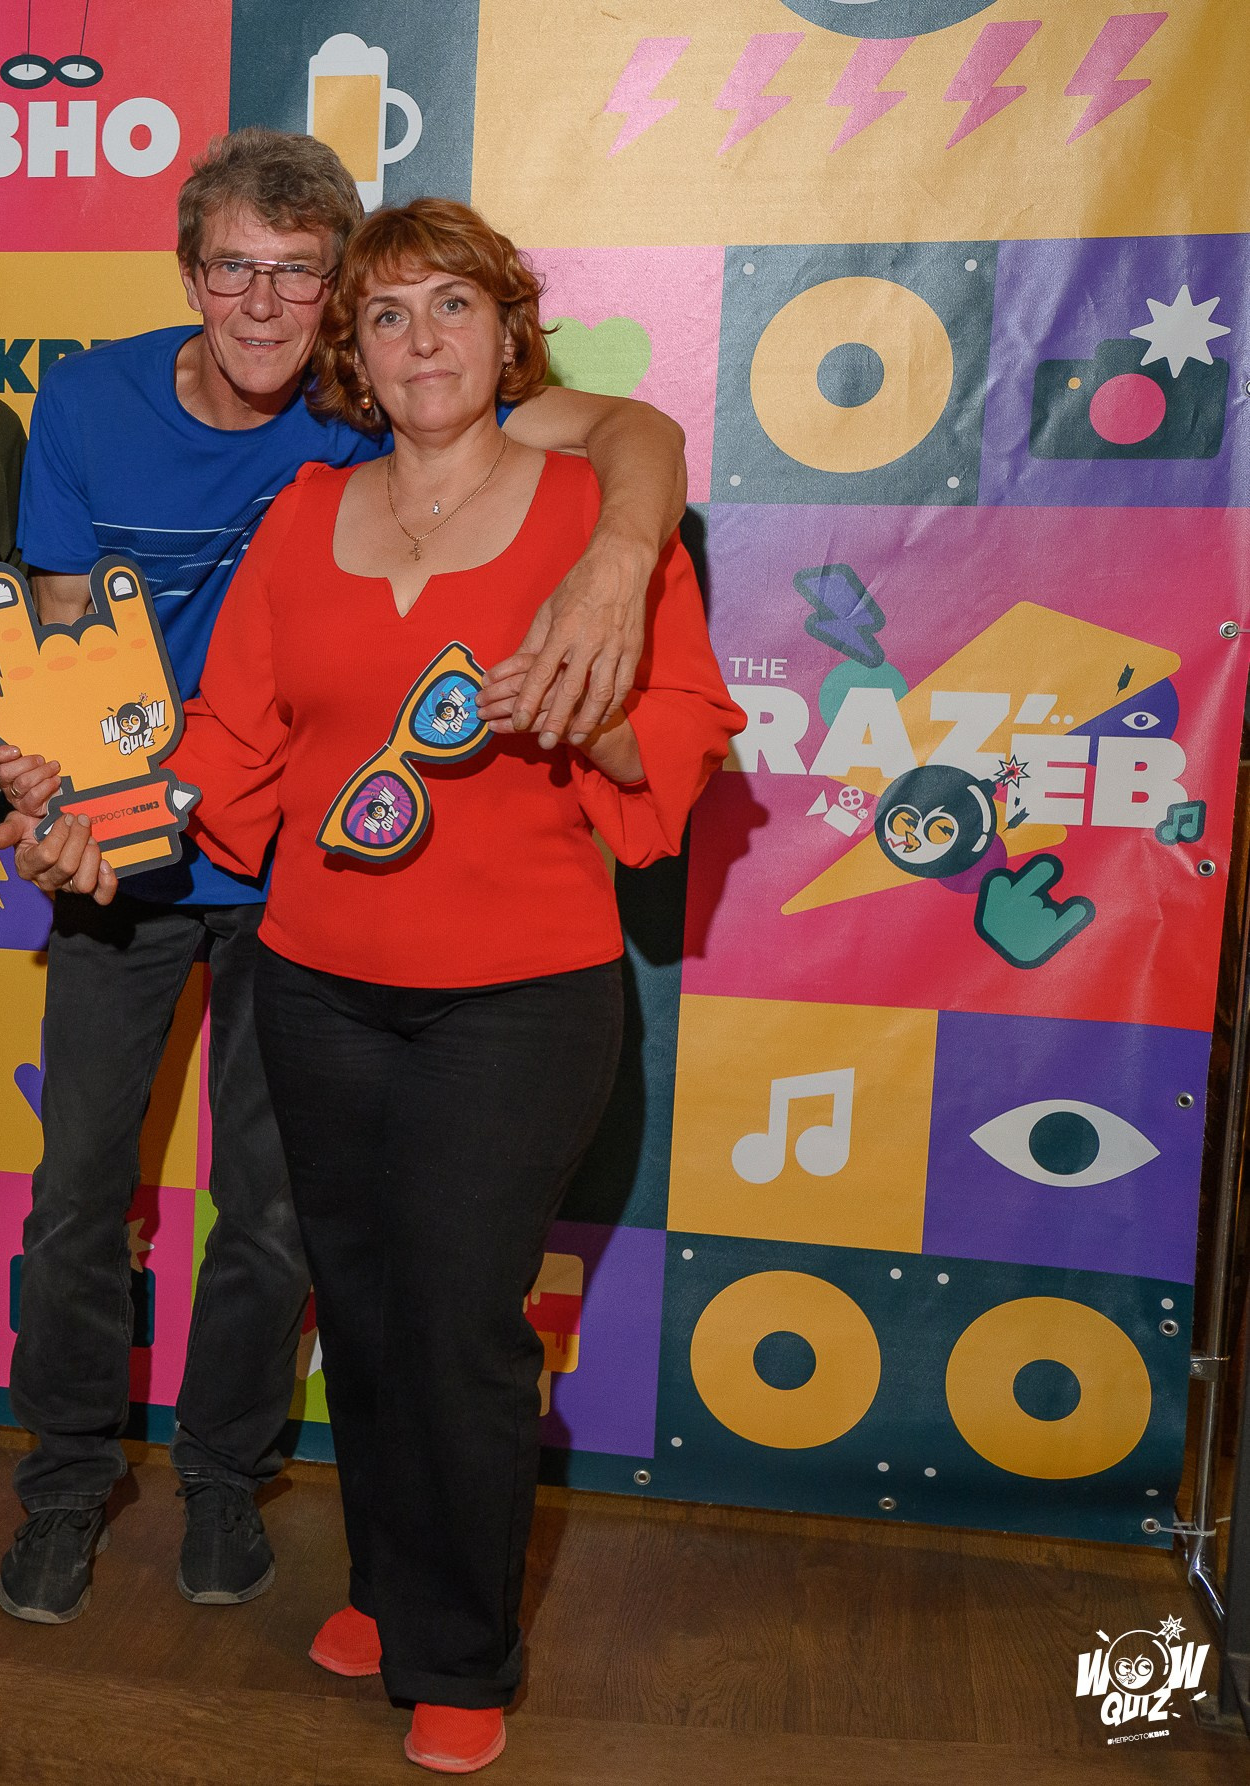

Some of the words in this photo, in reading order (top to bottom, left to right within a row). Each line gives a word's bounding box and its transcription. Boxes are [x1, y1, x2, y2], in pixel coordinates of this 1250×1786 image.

[728, 656, 788, 679] THE
[450, 706, 470, 733] QUIZ
[119, 728, 155, 755] QUIZ
[91, 801, 160, 825] ЕПРОСТОКВИЗ
[381, 805, 400, 832] QUIZ
